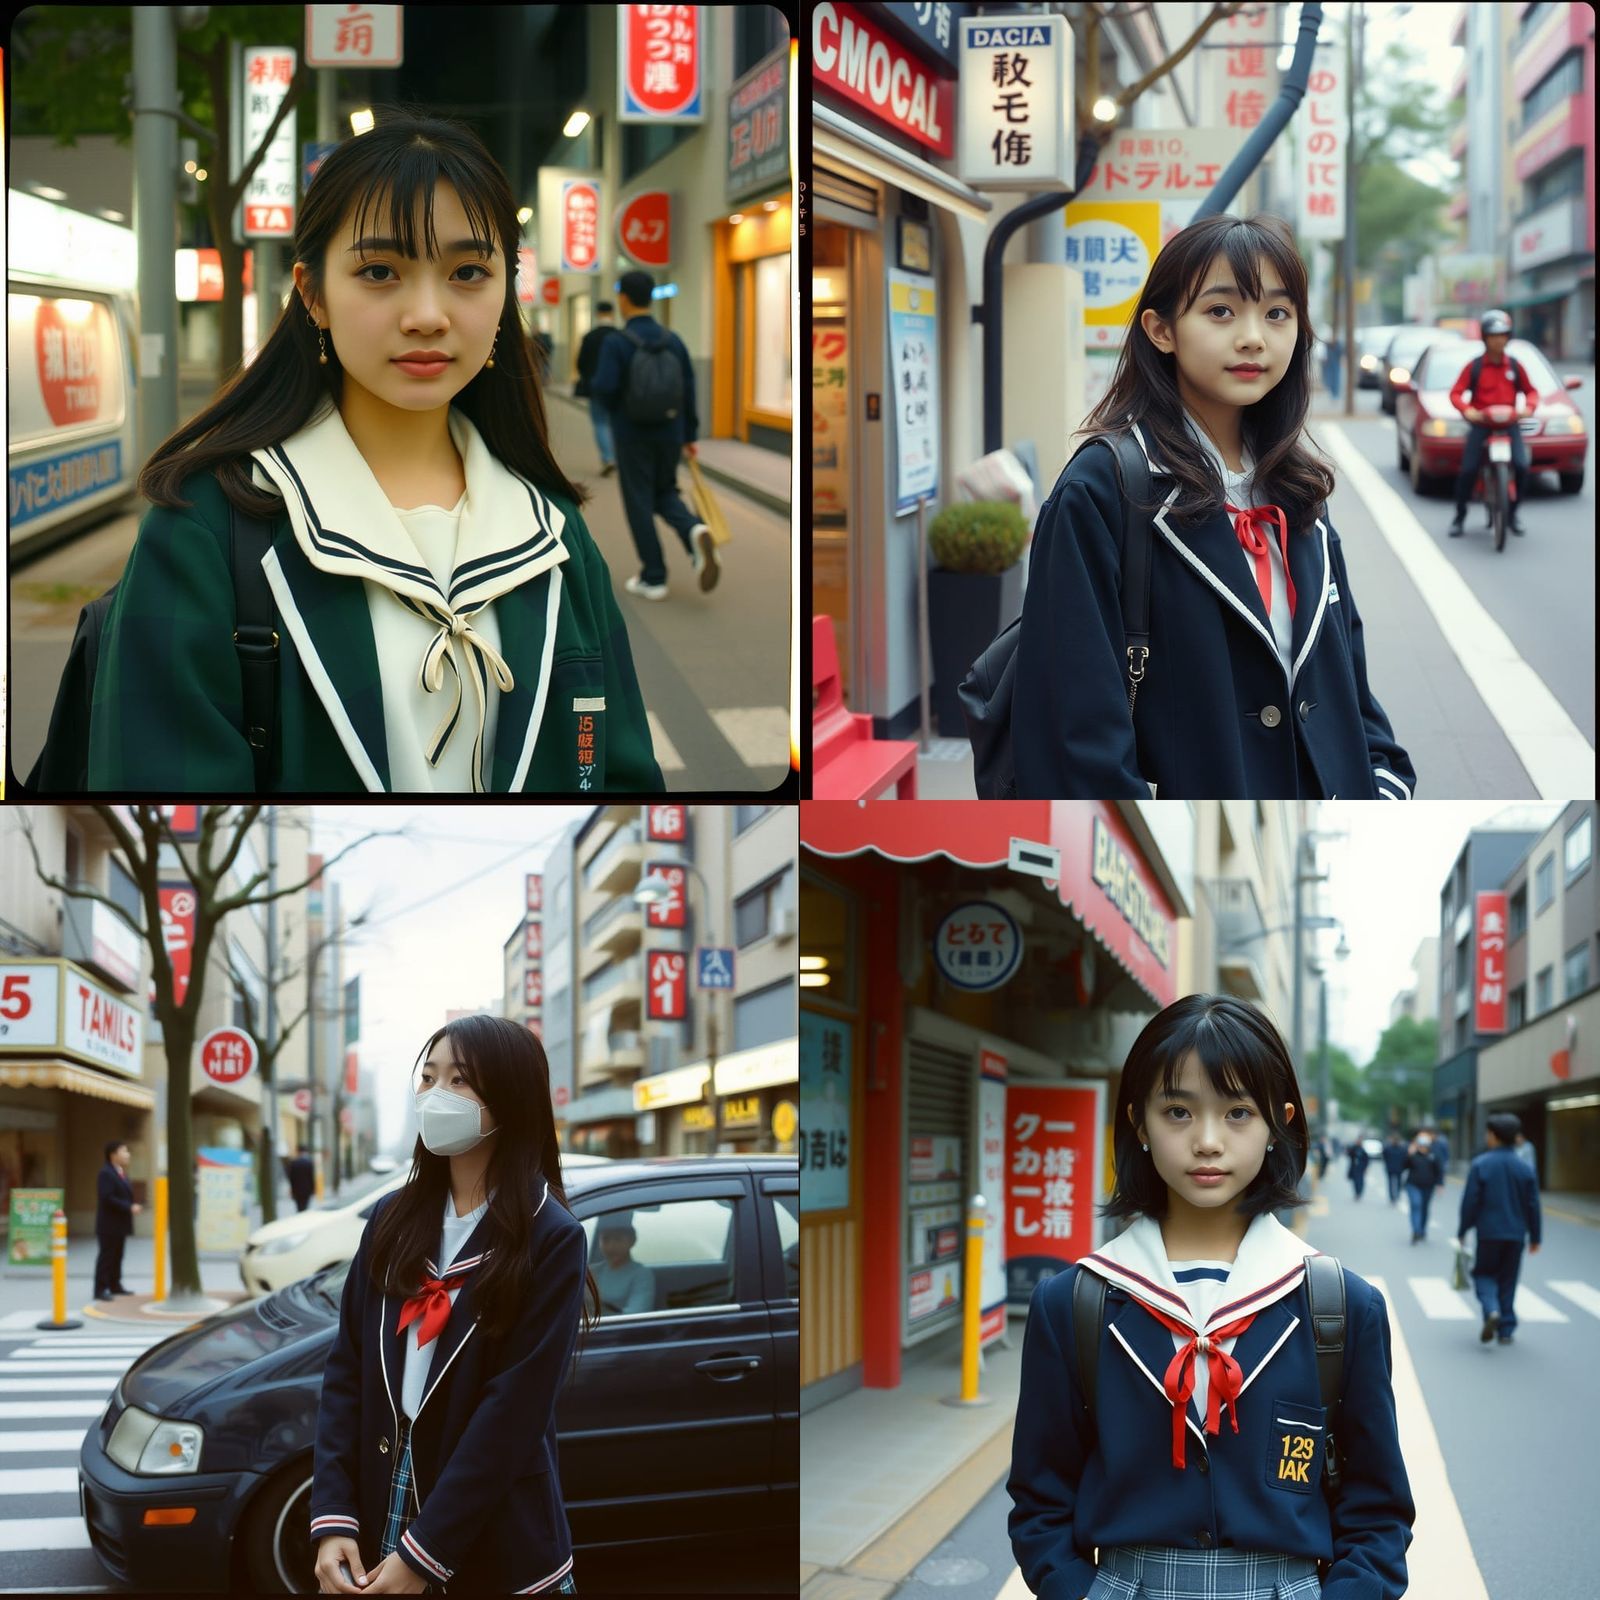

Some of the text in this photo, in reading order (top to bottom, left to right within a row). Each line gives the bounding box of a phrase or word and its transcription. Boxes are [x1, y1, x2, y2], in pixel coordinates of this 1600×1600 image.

[973, 27, 1045, 47] DACIA
[813, 3, 942, 142] CMOCAL
[252, 208, 287, 228] TA
